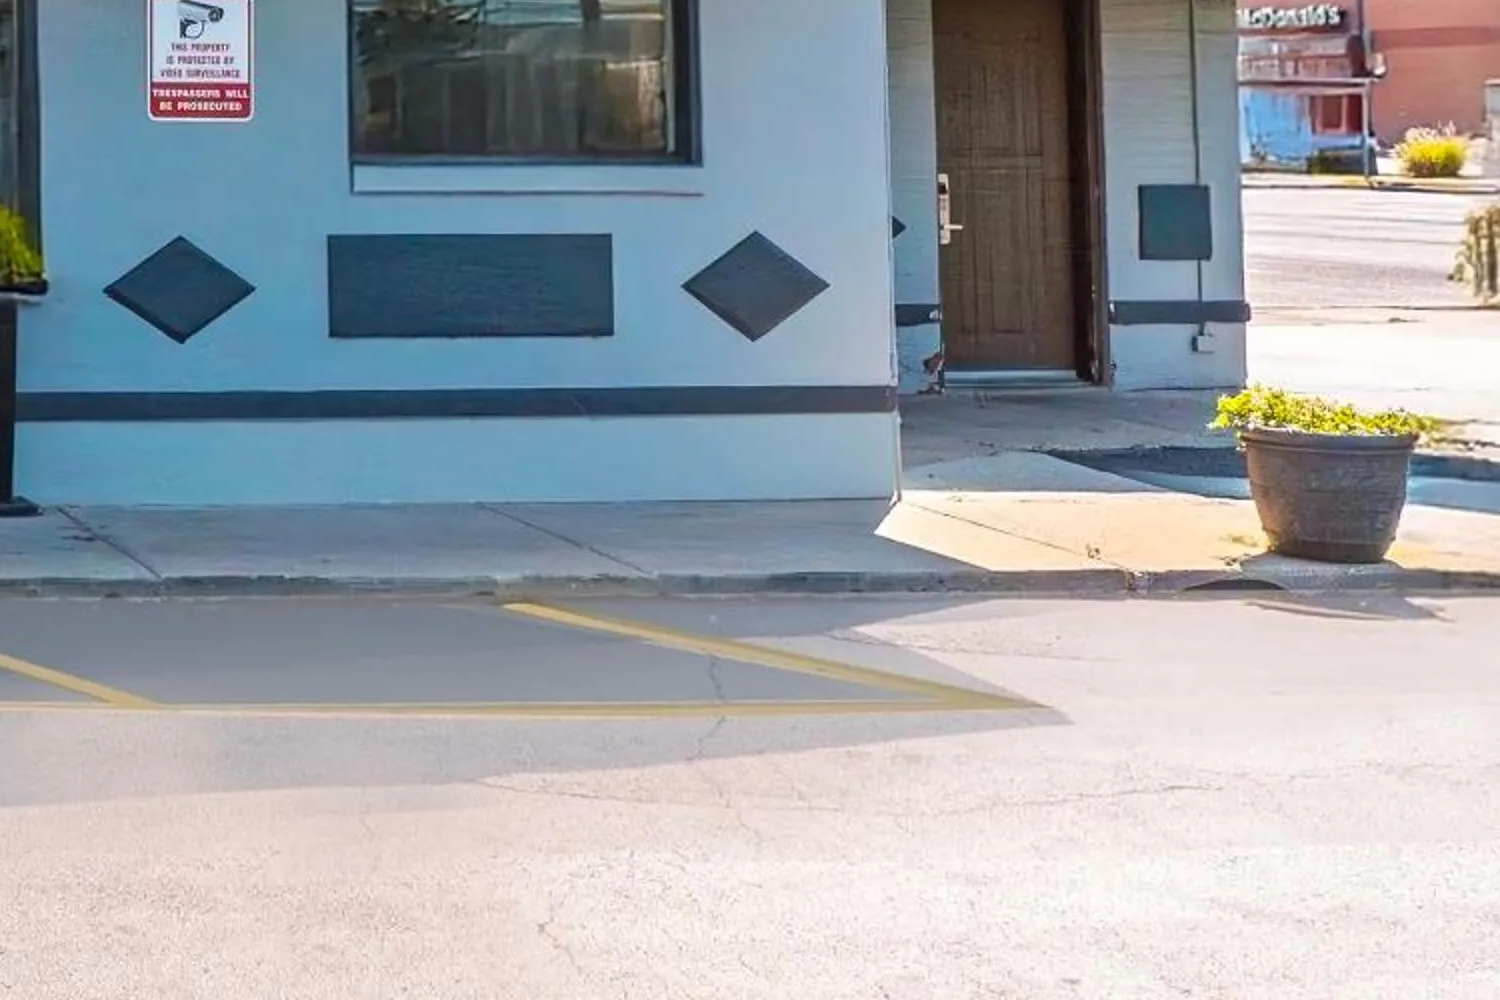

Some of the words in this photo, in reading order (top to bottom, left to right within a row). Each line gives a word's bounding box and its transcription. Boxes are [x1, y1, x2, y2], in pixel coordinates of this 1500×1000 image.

[191, 43, 230, 52] PROPERTY
[153, 89, 221, 98] TRESPASSERS
[225, 89, 249, 99] WILL
[160, 101, 172, 111] BE
[177, 101, 242, 111] PROSECUTED
